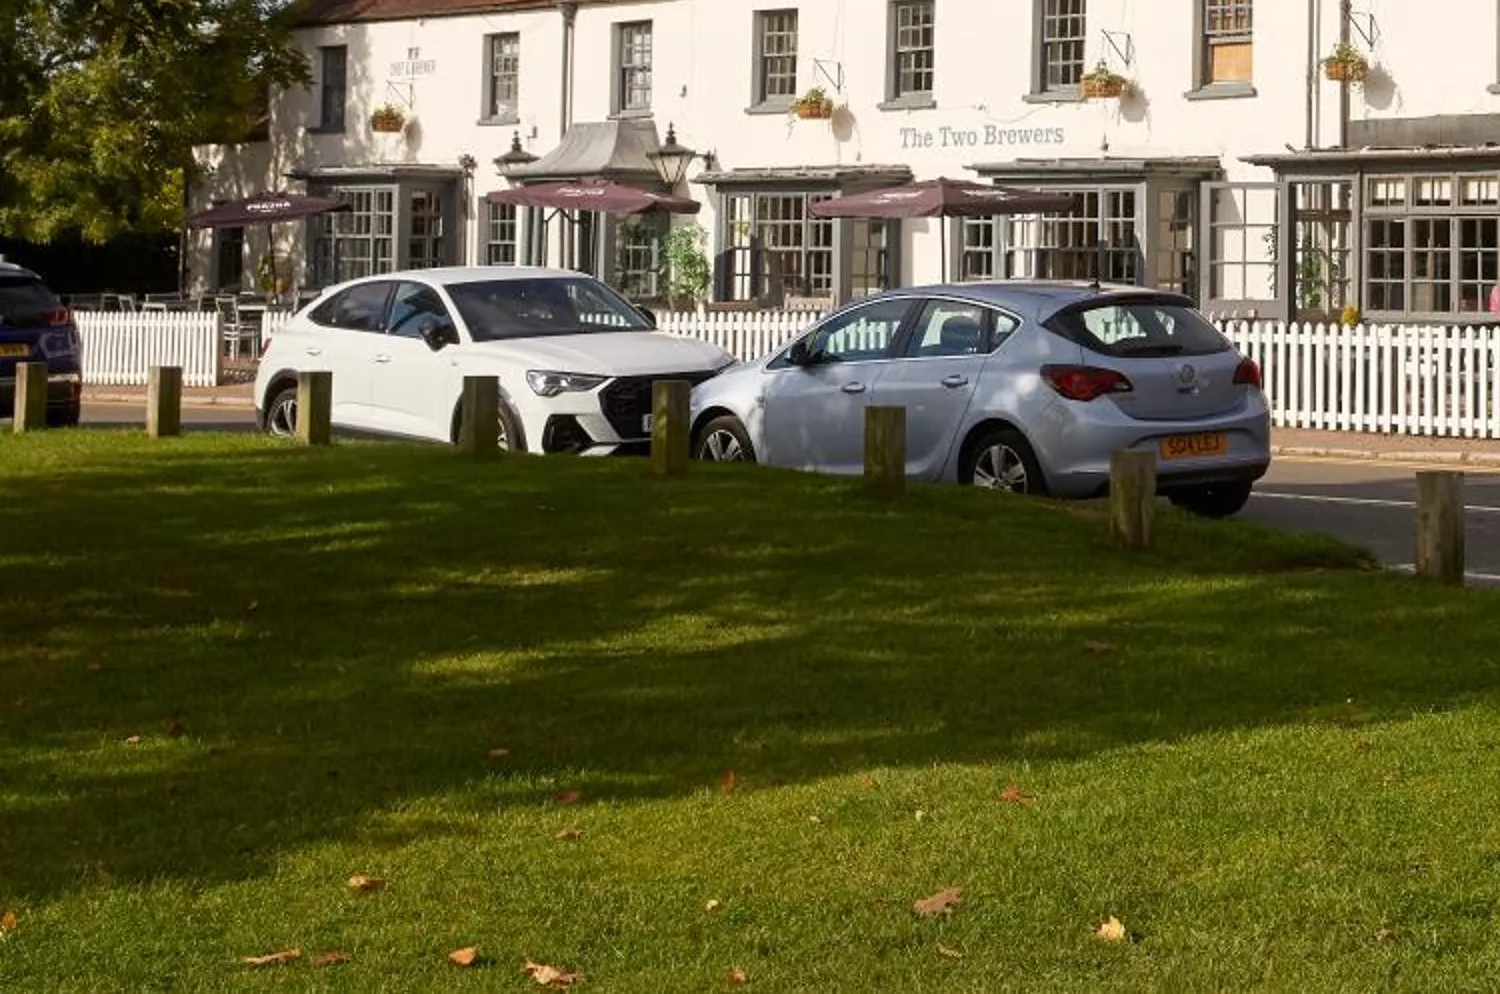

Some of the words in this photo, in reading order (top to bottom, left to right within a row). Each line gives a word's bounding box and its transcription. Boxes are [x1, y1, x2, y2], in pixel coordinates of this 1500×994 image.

[900, 127, 933, 150] The
[939, 126, 978, 147] Two
[983, 124, 1064, 145] Brewers
